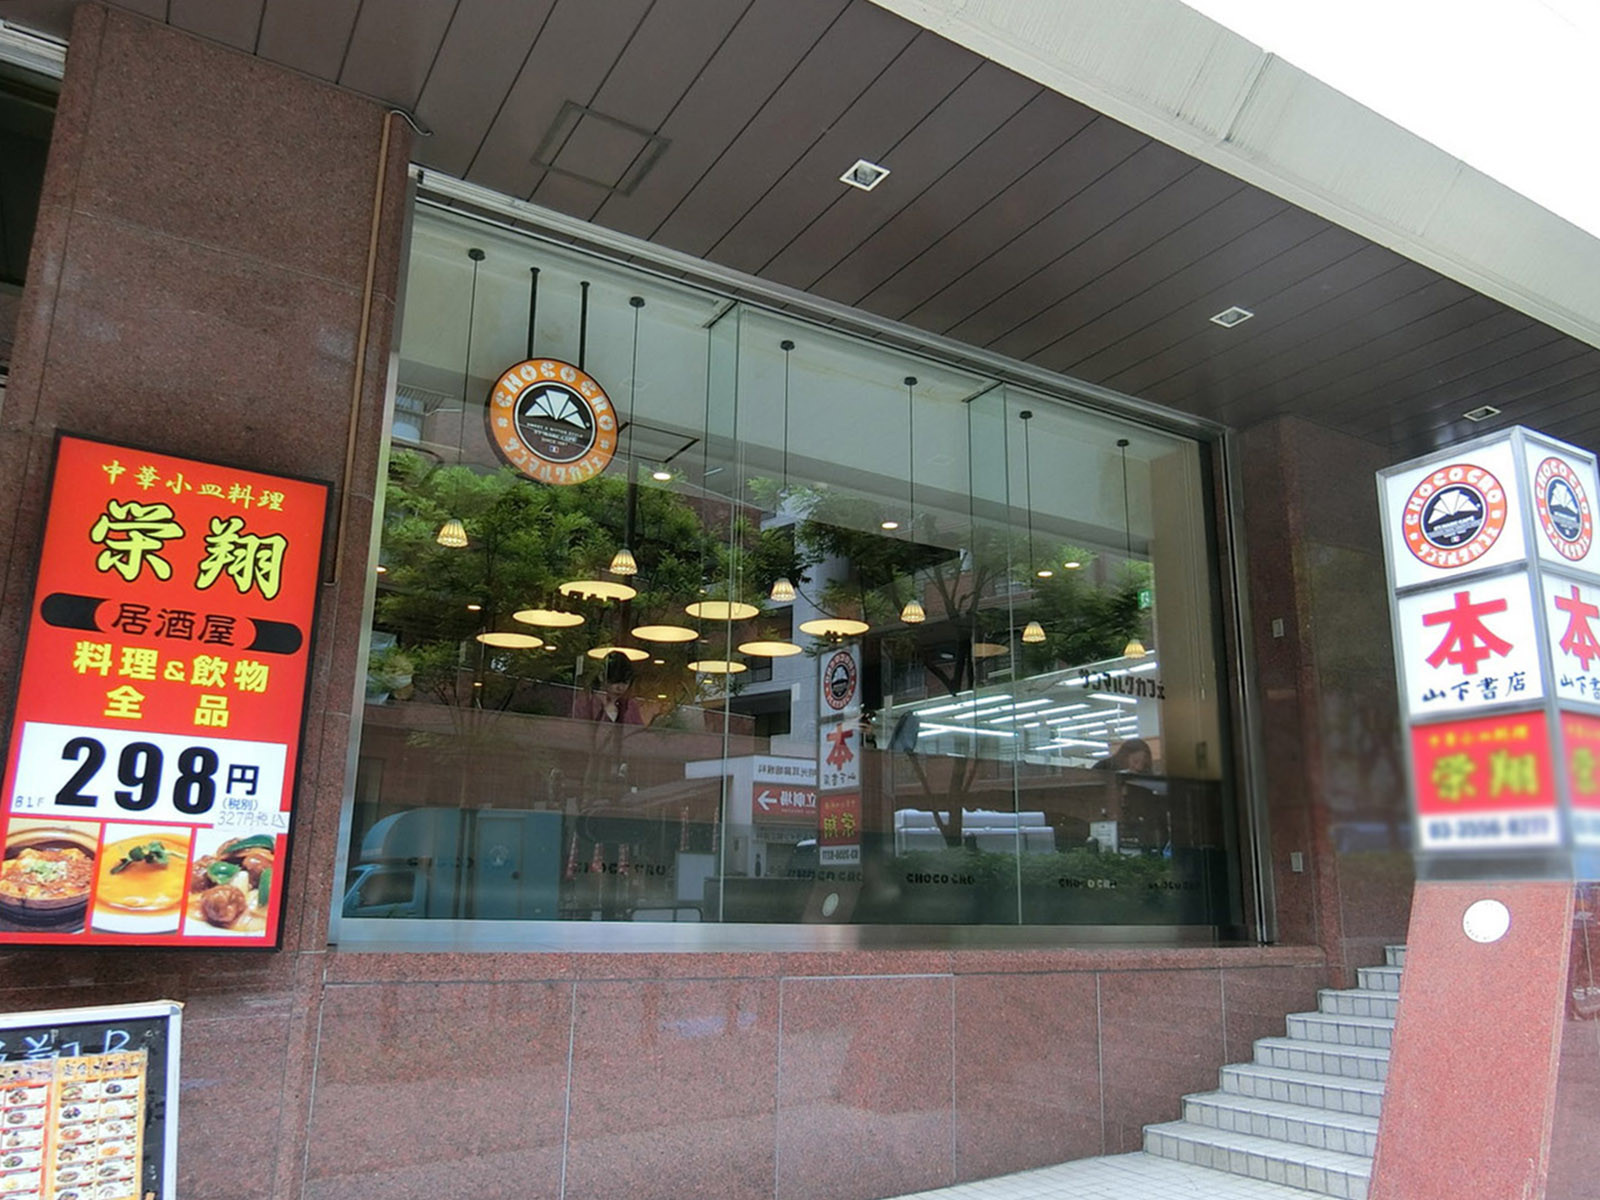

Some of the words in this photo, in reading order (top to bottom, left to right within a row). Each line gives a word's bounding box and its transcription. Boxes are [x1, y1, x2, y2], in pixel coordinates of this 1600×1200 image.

[495, 362, 577, 408] CHOCO
[580, 380, 614, 432] CRO
[102, 460, 286, 512] 中華小皿料理
[1405, 467, 1464, 526] CHOCO
[1466, 469, 1502, 505] CRO
[90, 499, 289, 600] 栄翔
[112, 603, 237, 647] 居酒屋
[1422, 591, 1514, 675] 本
[1555, 595, 1600, 672] 本
[73, 640, 270, 694] 料理&飲物
[1421, 672, 1526, 702] 山下書店
[906, 872, 949, 885] CHOCO
